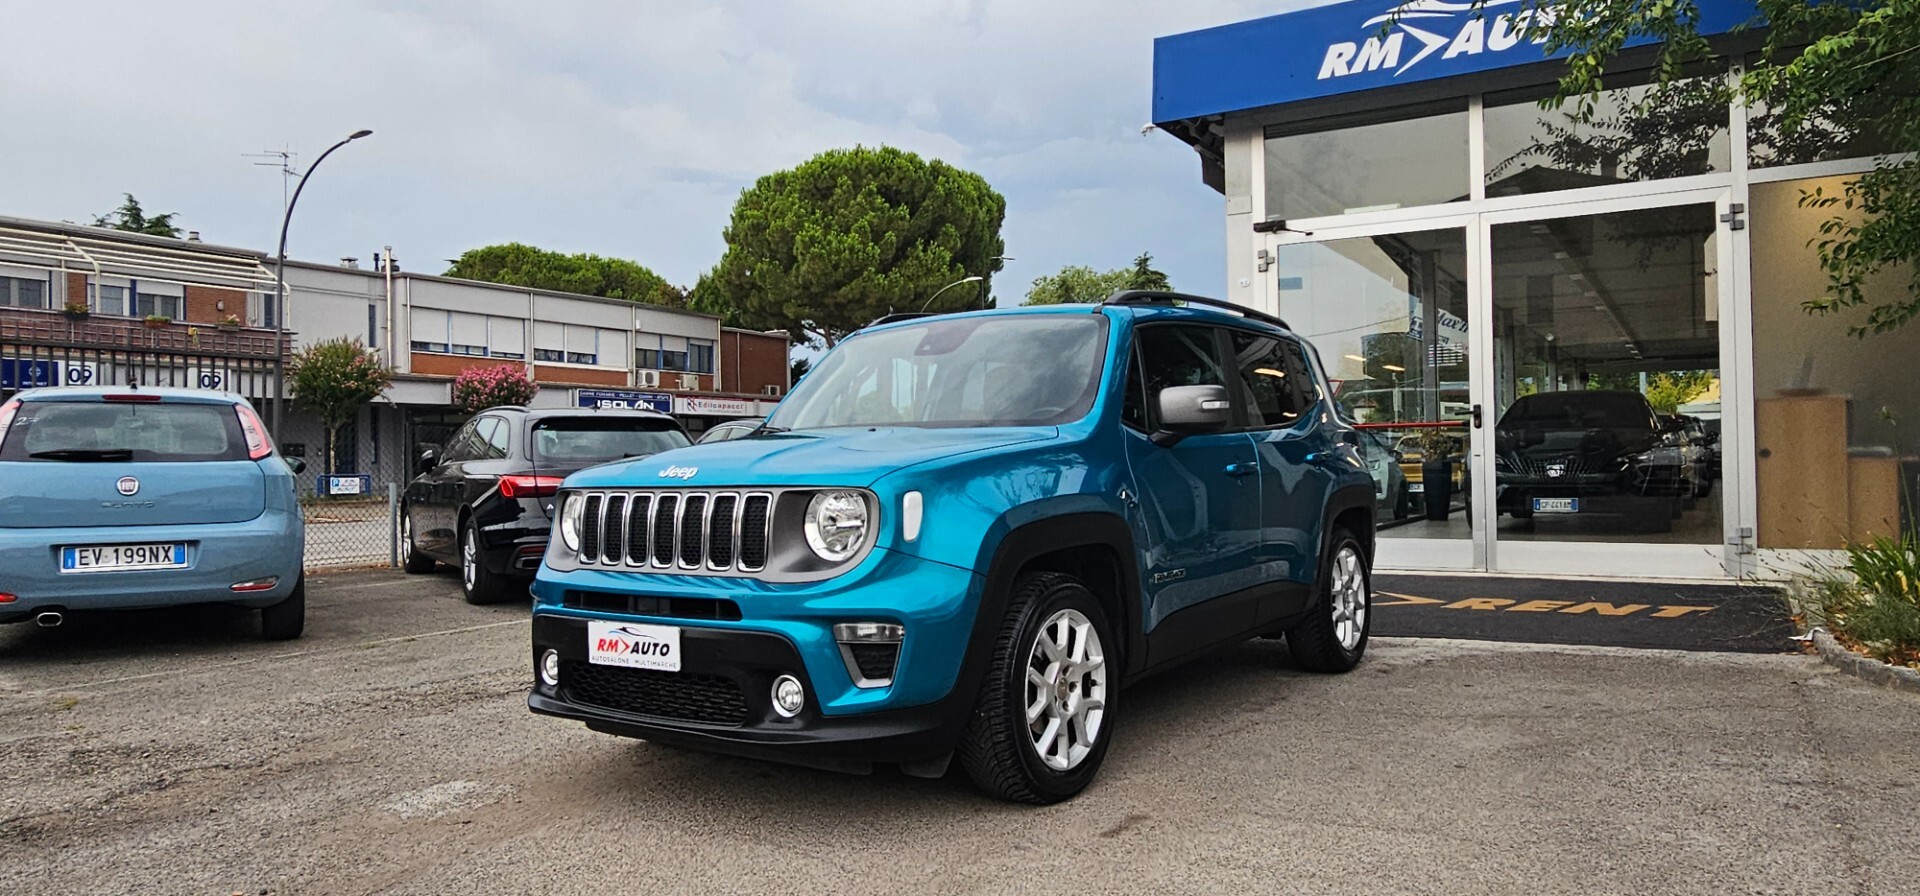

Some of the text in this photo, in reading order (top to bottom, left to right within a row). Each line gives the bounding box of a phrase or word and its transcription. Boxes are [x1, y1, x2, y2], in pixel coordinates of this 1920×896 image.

[1317, 33, 1404, 80] RM
[597, 400, 654, 410] ISOLAN
[658, 465, 699, 480] Jeep
[79, 546, 172, 566] EV 199NX
[1441, 598, 1718, 617] RENT
[597, 638, 670, 657] RM AUTO
[591, 656, 629, 664] AUTOSALONE
